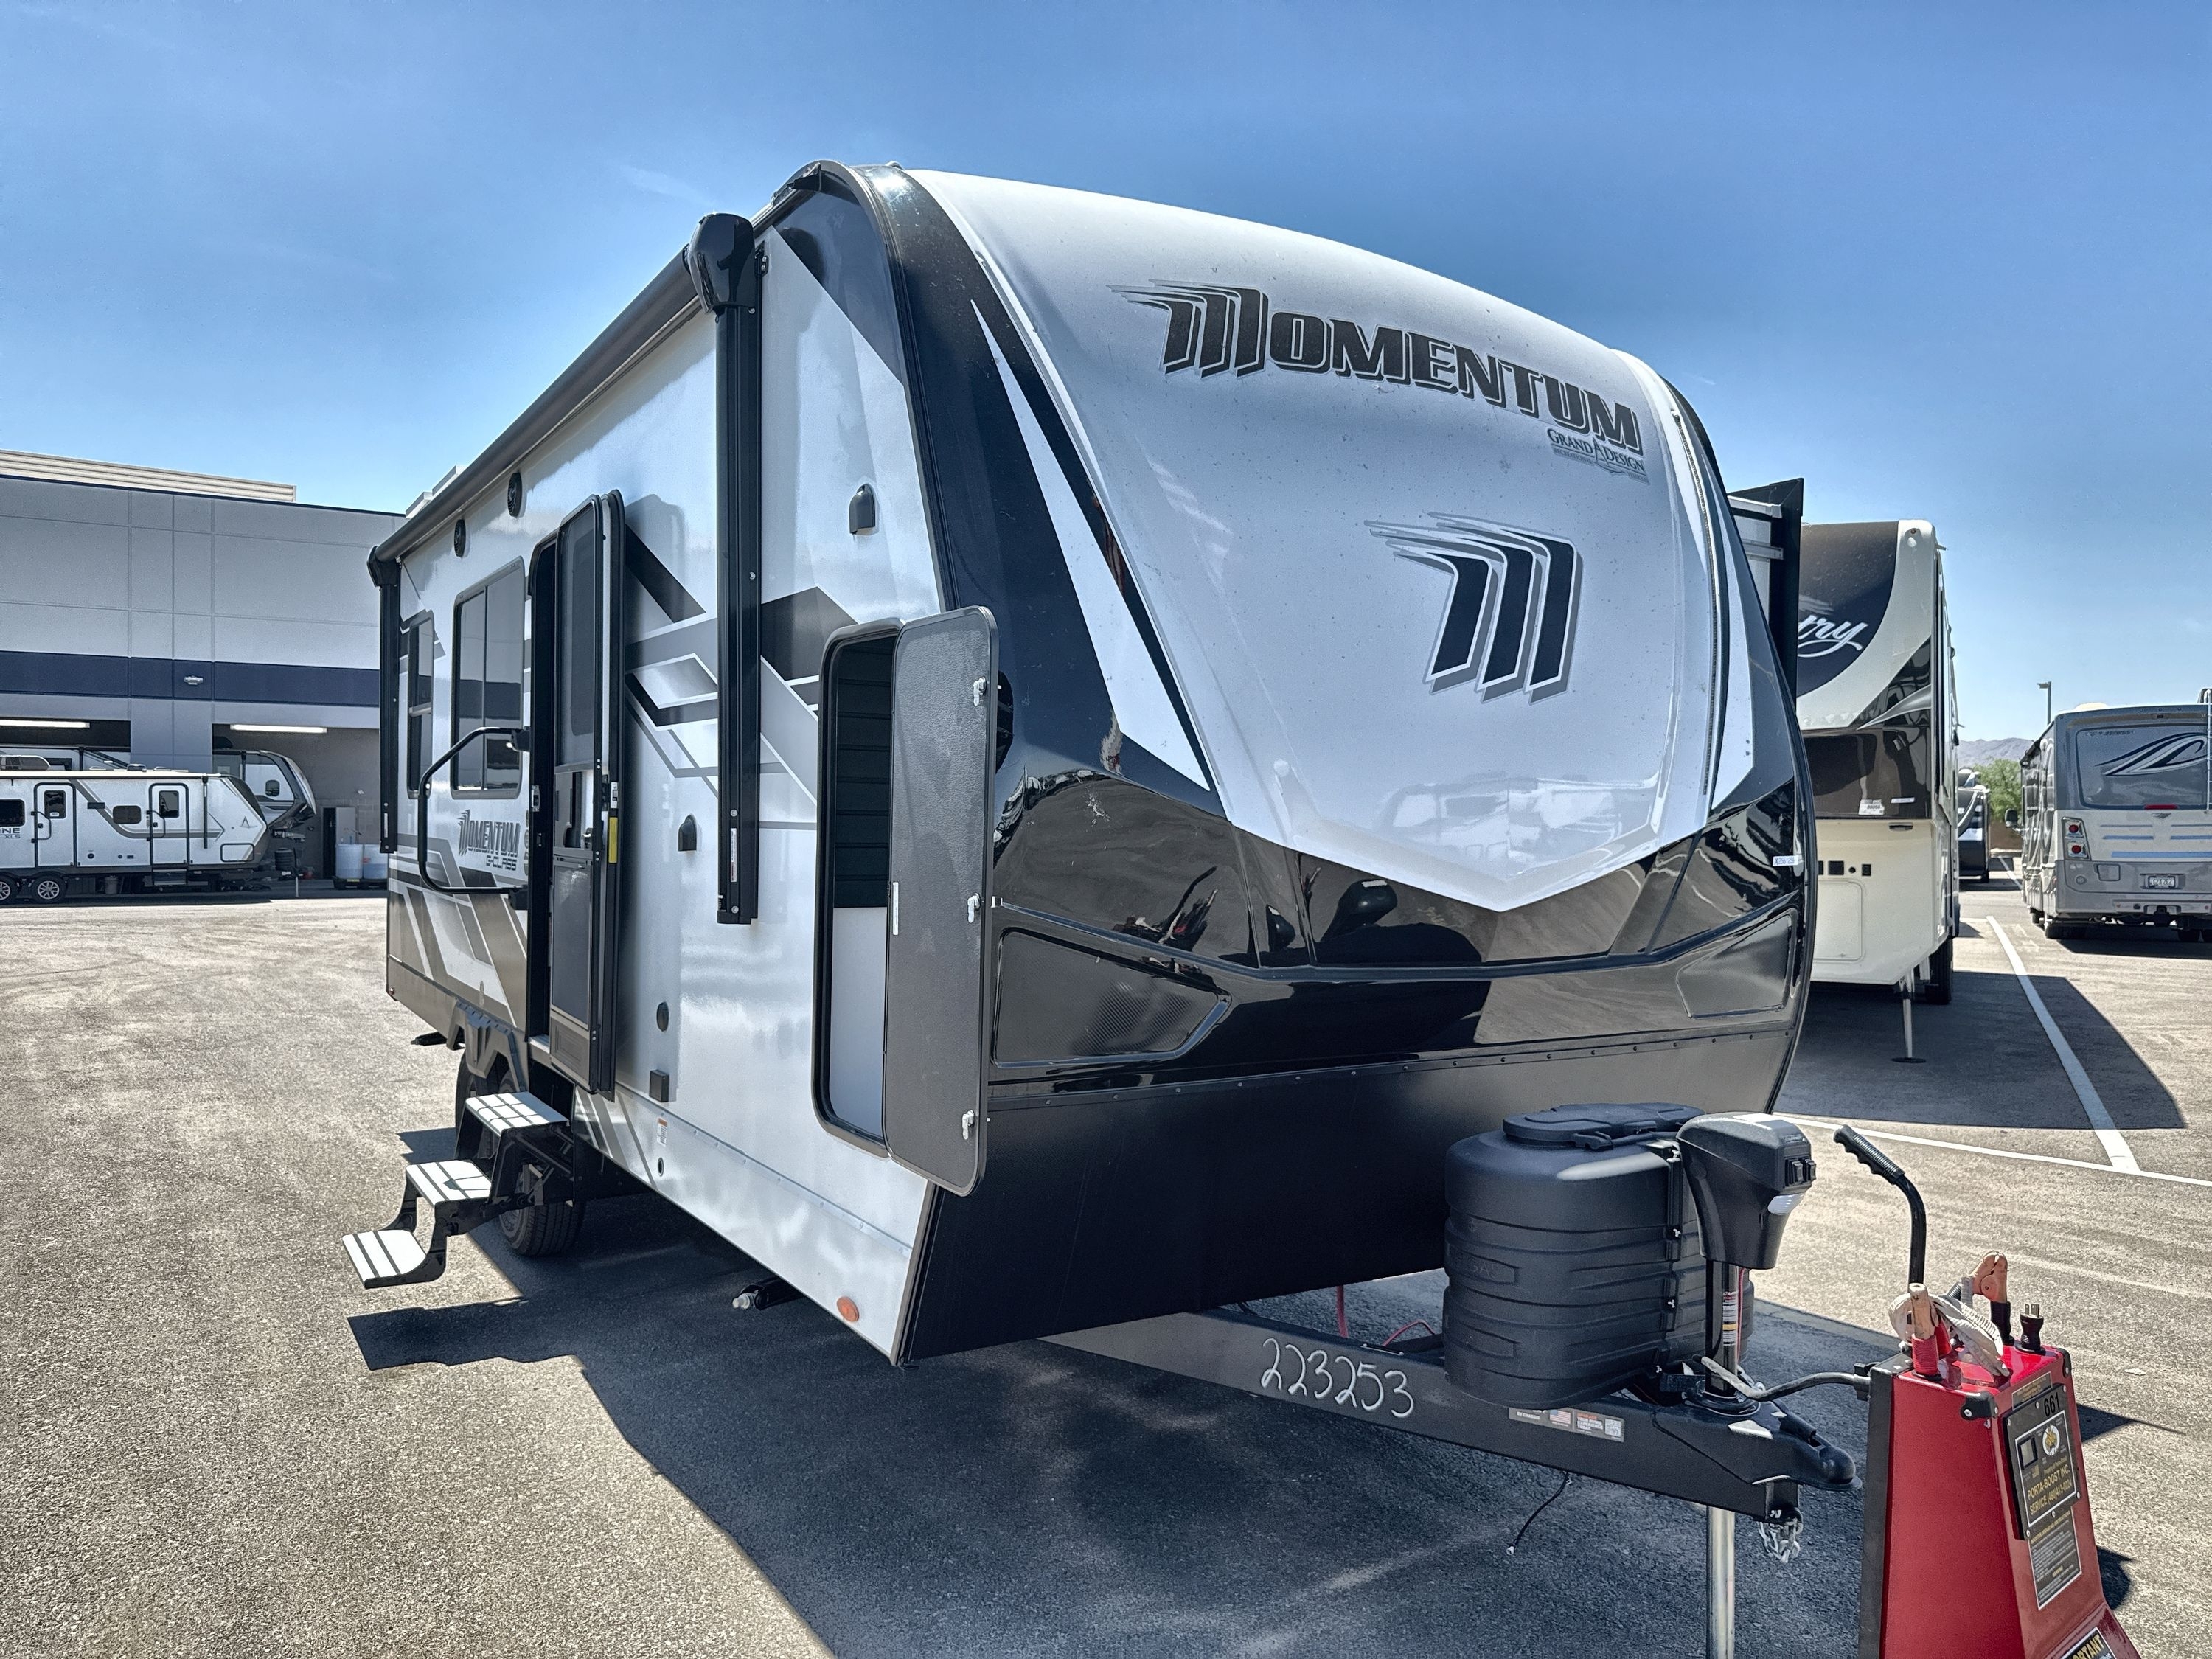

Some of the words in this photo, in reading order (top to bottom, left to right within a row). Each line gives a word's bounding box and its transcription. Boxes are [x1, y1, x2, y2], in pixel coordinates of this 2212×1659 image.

[1107, 279, 1643, 455] MOMENTUM
[1547, 428, 1593, 454] GRAND
[1602, 446, 1646, 472] DESIGN
[457, 809, 521, 858] MOMENTUM
[486, 855, 518, 871] G-CLASS
[1261, 1338, 1414, 1418] 223253
[2044, 1392, 2060, 1417] 661
[2027, 1470, 2061, 1500] PORTA-BOOST
[2029, 1495, 2048, 1515] SERVICE
